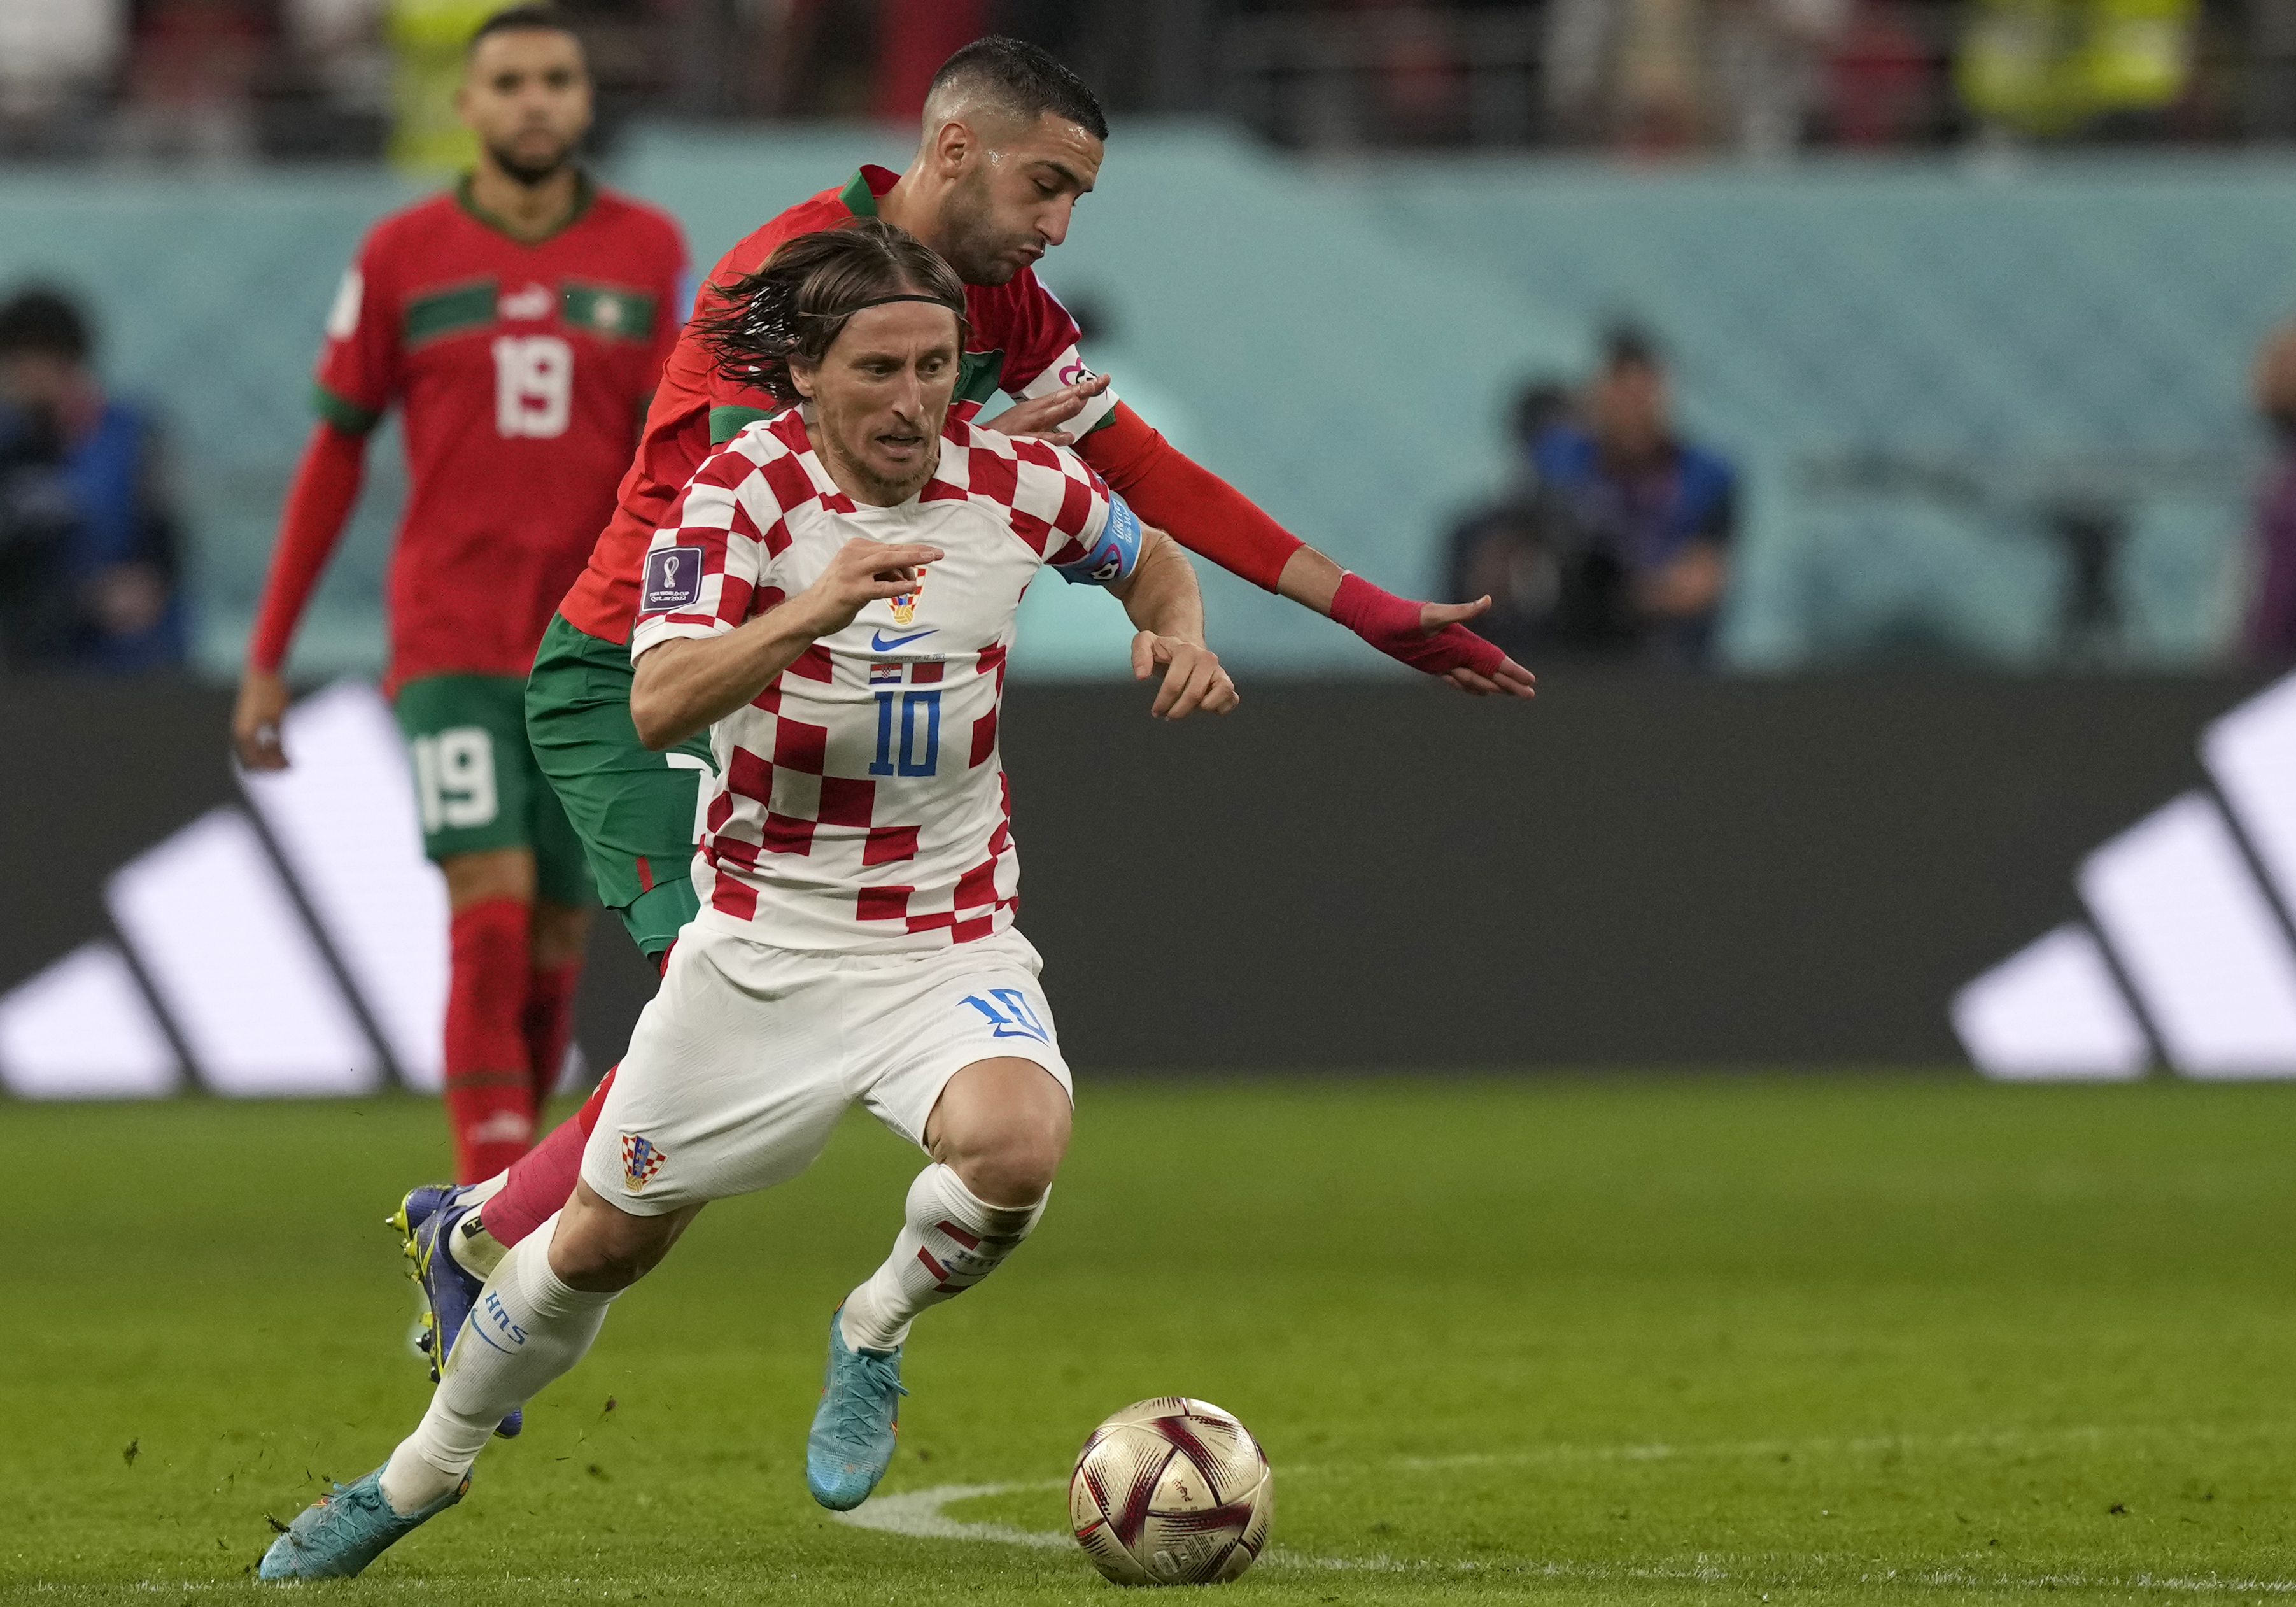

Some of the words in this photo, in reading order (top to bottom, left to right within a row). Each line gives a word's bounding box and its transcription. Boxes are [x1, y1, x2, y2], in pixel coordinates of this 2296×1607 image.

[493, 335, 574, 438] 19
[414, 726, 499, 835] 19
[868, 690, 942, 777] 10
[955, 989, 1050, 1042] 10
